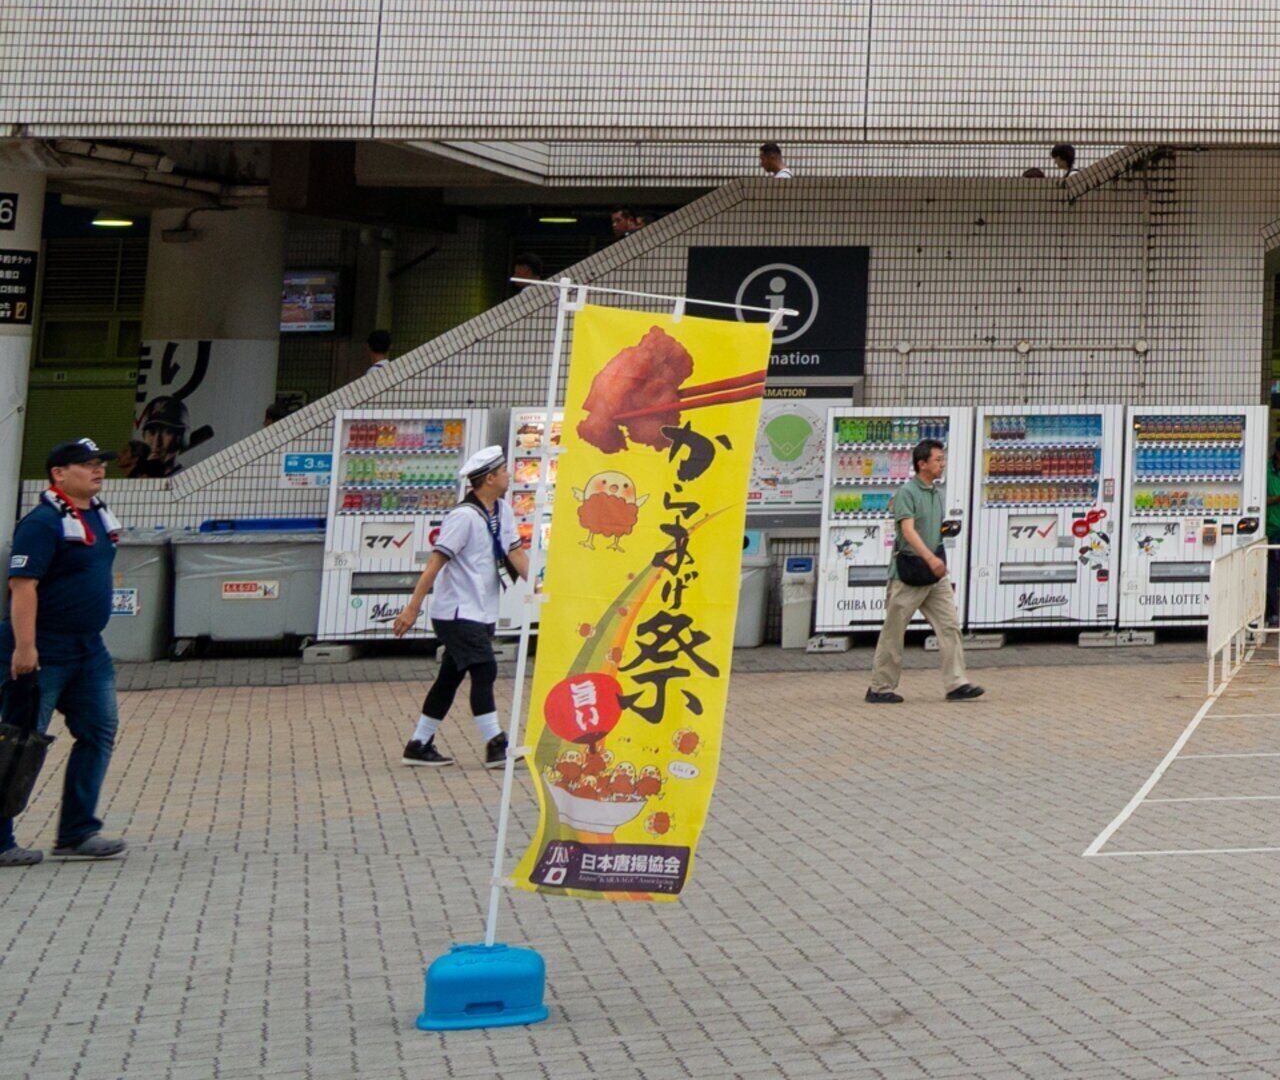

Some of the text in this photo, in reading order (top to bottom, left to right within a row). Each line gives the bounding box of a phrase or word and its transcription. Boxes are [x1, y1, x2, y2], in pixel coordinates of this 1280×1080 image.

[617, 421, 732, 724] からあげ祭
[837, 600, 866, 610] CHIBA
[1016, 592, 1069, 612] Marines
[1138, 596, 1168, 606] CHIBA
[1171, 595, 1201, 606] LOTTE
[581, 853, 680, 874] 日本唐揚協会
